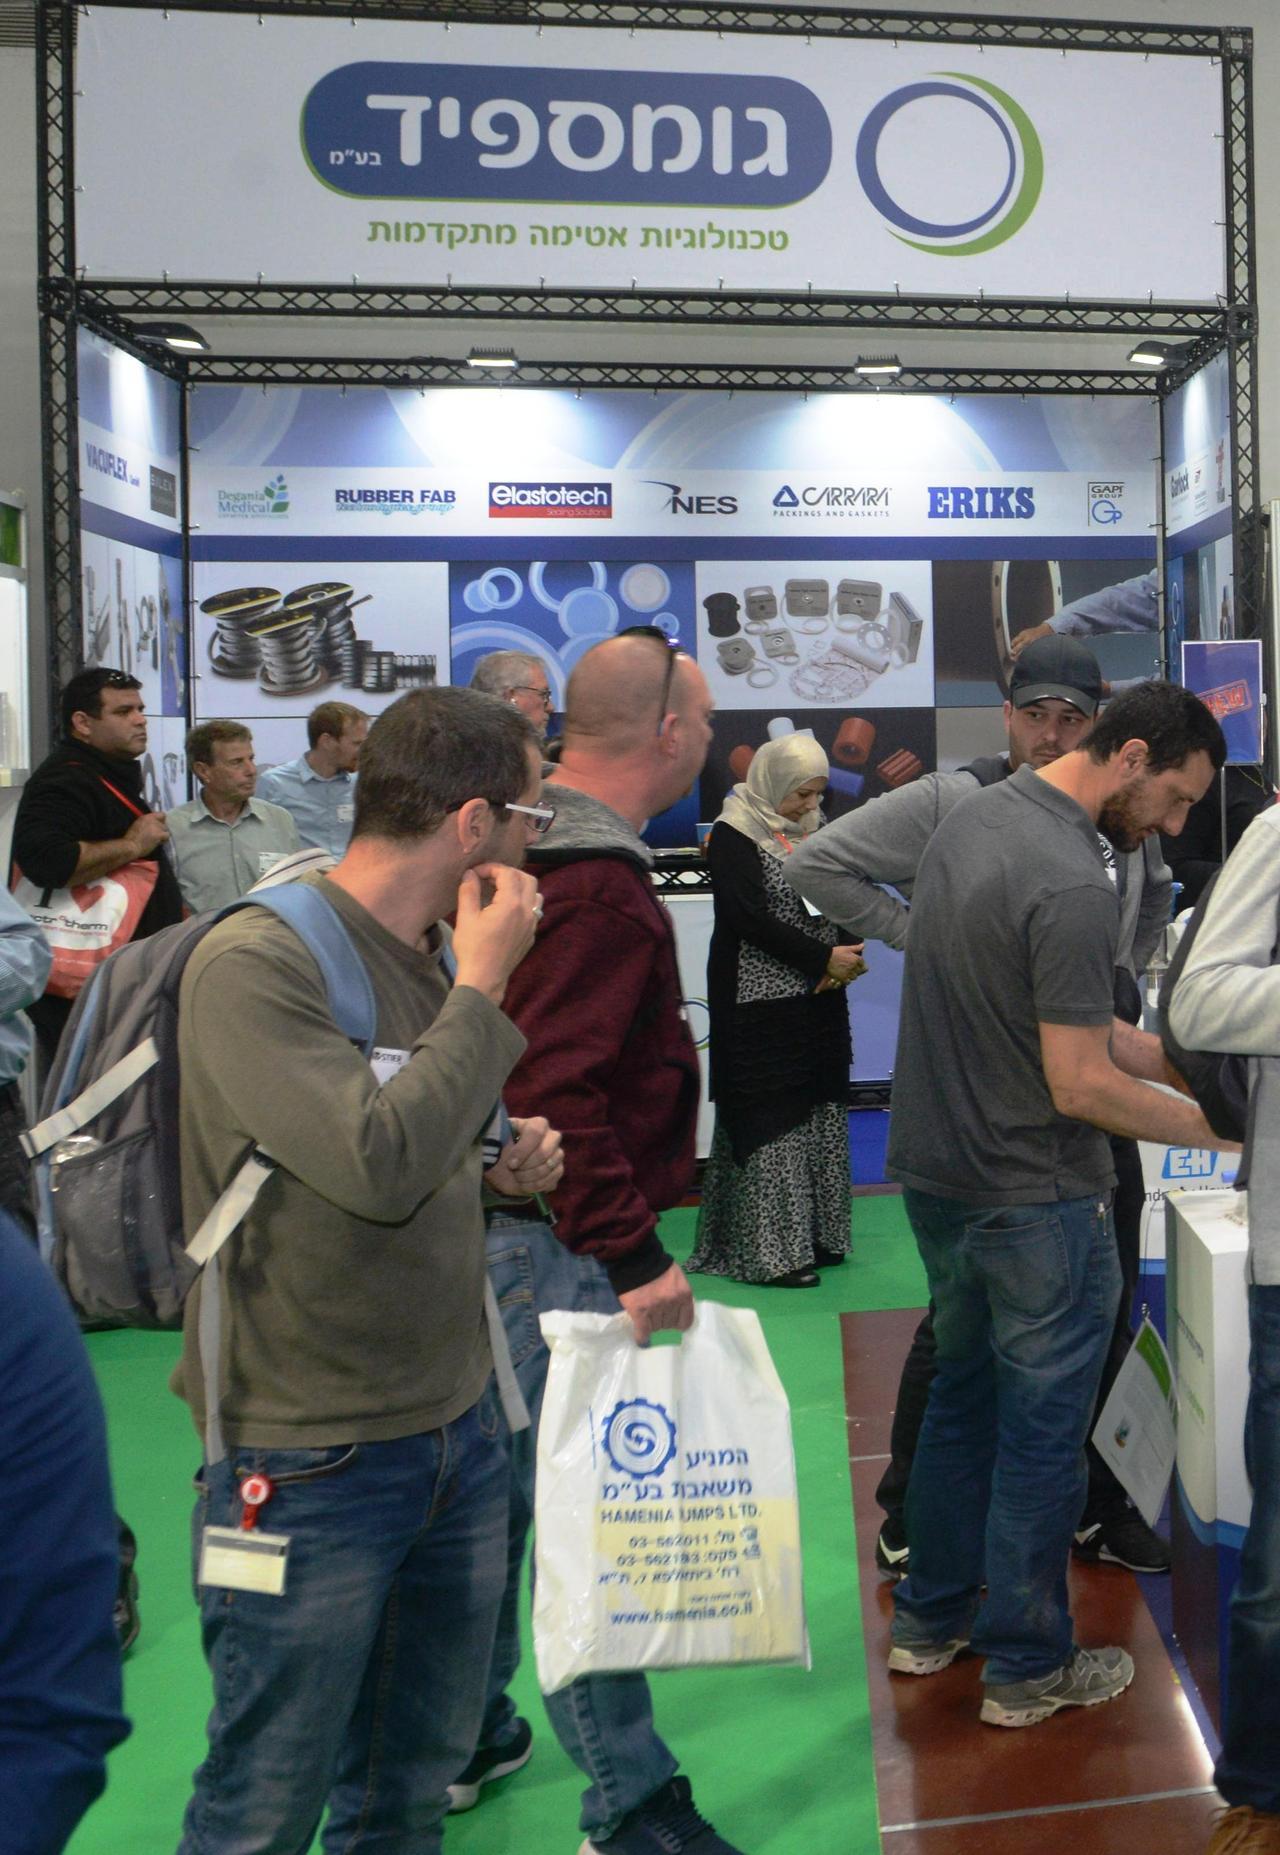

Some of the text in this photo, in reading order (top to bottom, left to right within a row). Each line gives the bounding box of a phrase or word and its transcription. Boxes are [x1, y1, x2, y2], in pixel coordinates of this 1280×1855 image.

[329, 94, 788, 177] גומספיד בע"מ
[367, 220, 789, 251] טכנולוגיות אטימה מתקדמות
[218, 490, 265, 503] Degania
[335, 490, 456, 503] RUBBER FAB
[492, 485, 608, 505] elastotech
[802, 487, 889, 506] CARRARA
[1091, 485, 1123, 494] GAPI
[218, 501, 270, 513] Medical
[671, 496, 738, 515] NES
[927, 486, 1036, 519] ERIKS
[685, 1448, 750, 1470] המניע
[603, 1482, 664, 1502] בע"מ
[600, 1507, 673, 1525] HAMENIA
[678, 1504, 725, 1523] UMPS
